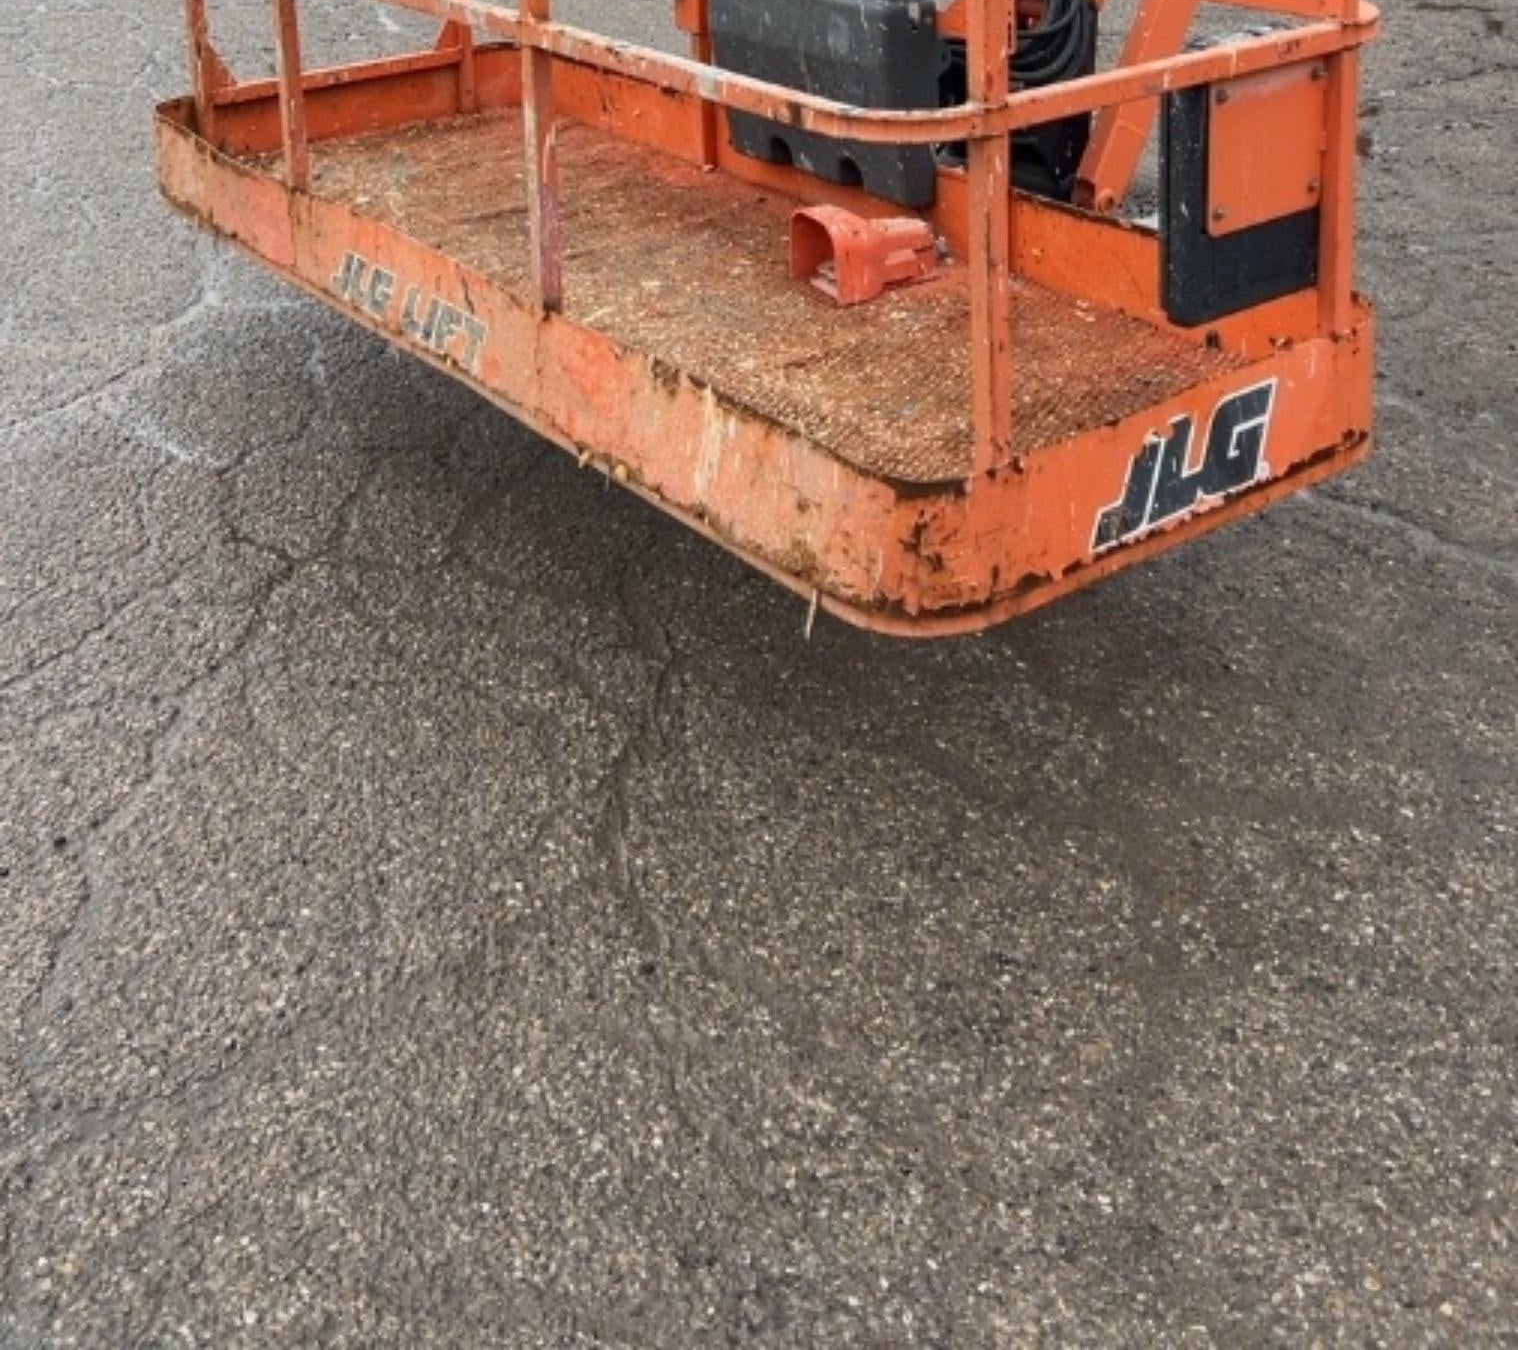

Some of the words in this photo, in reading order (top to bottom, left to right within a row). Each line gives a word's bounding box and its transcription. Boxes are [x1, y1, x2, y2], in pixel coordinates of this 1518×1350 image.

[331, 250, 395, 320] JLG
[401, 285, 489, 374] LIFT
[1090, 377, 1279, 554] JLG
